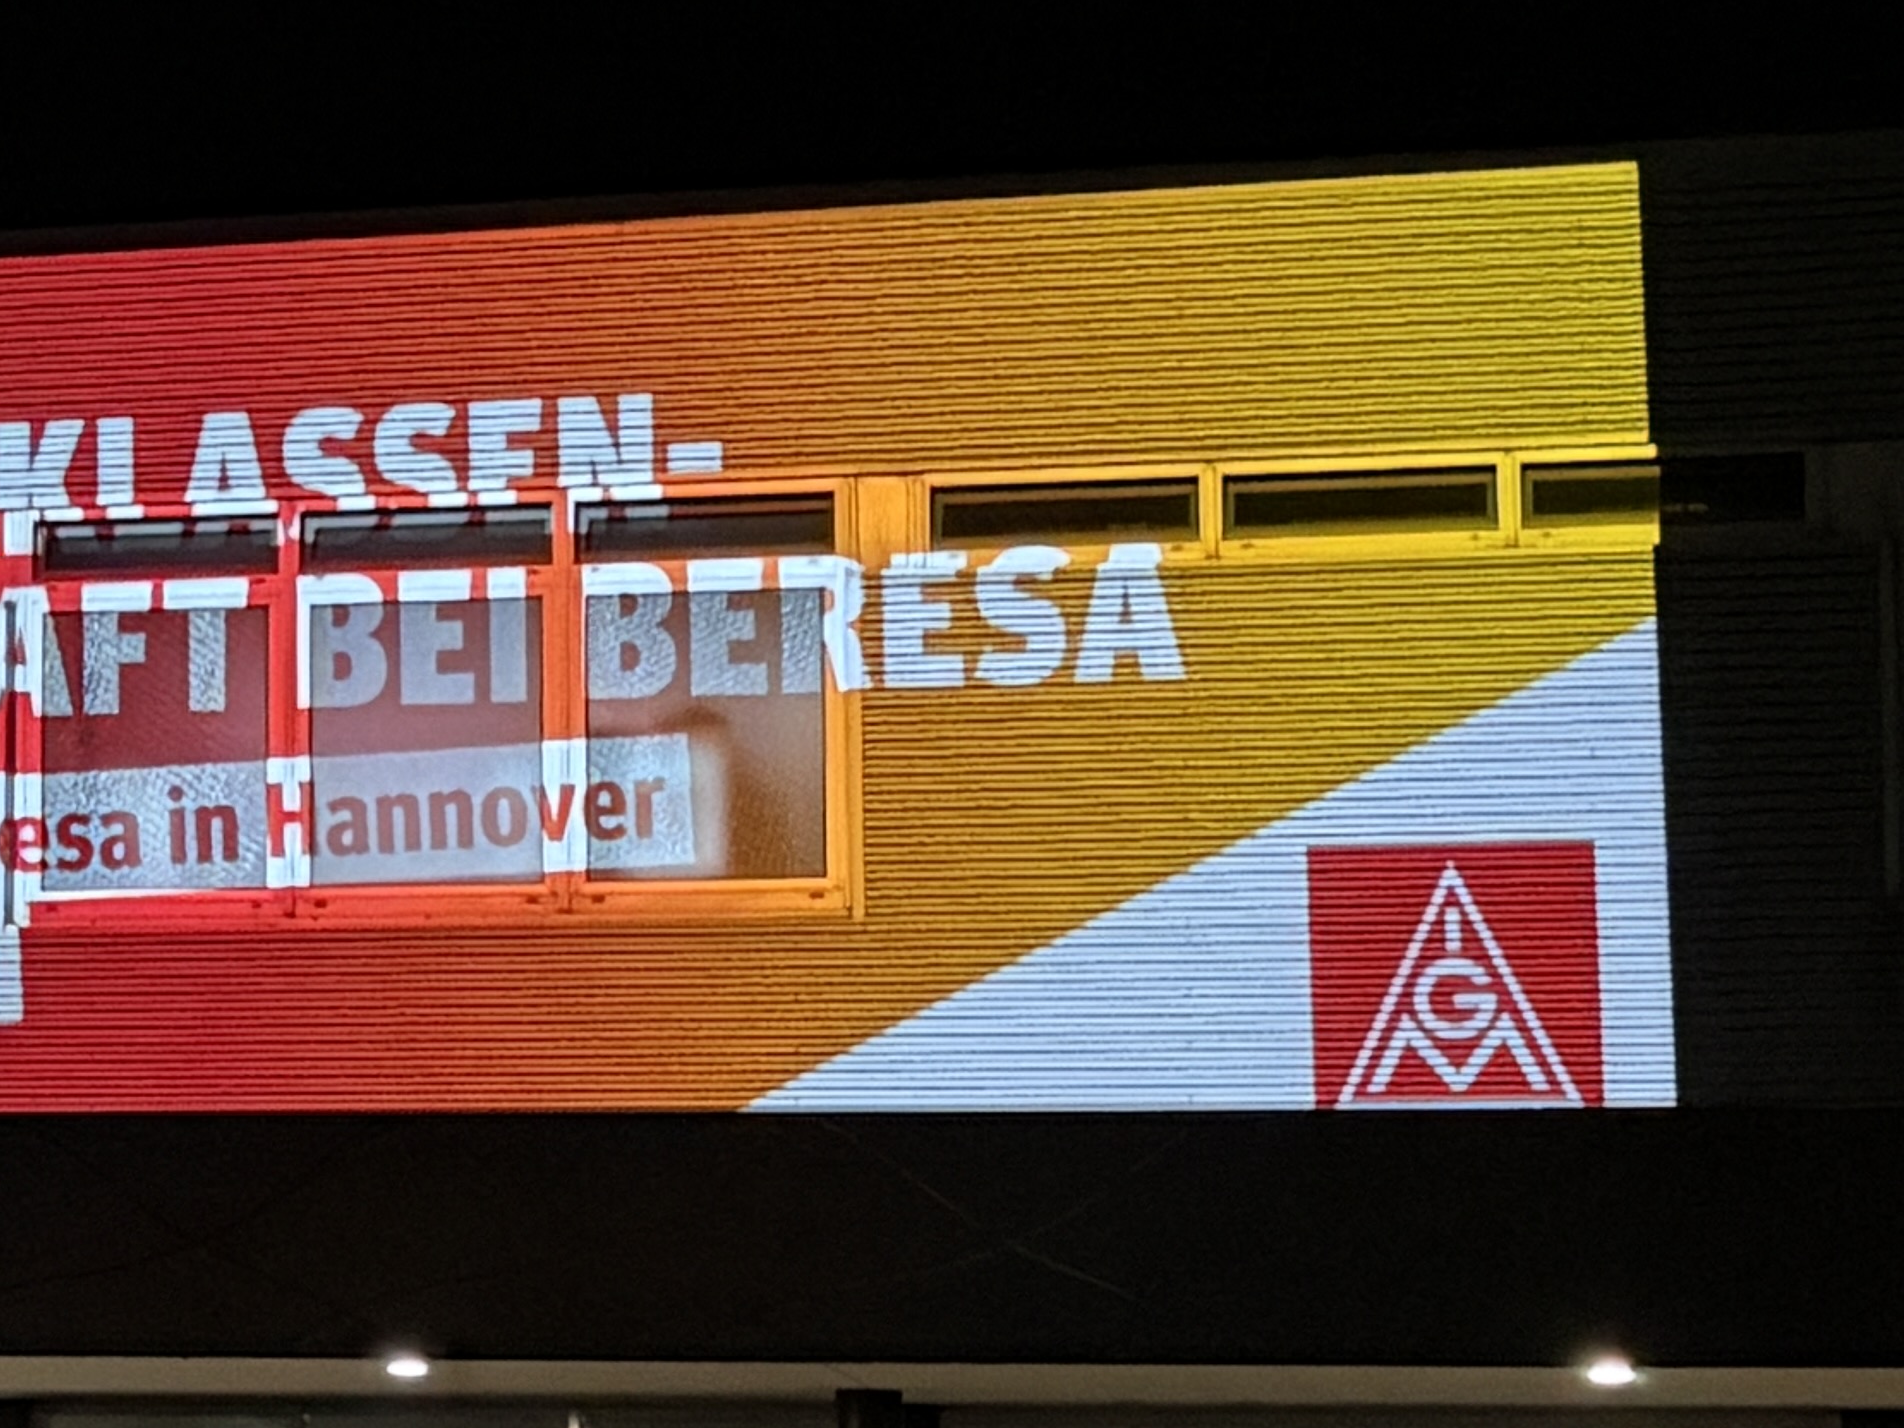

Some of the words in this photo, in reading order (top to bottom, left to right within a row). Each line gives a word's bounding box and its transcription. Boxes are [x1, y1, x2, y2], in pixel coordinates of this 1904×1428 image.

[296, 565, 530, 710] BEI
[582, 542, 1186, 704] BERESA
[168, 785, 242, 865] in
[267, 774, 669, 858] Hannover
